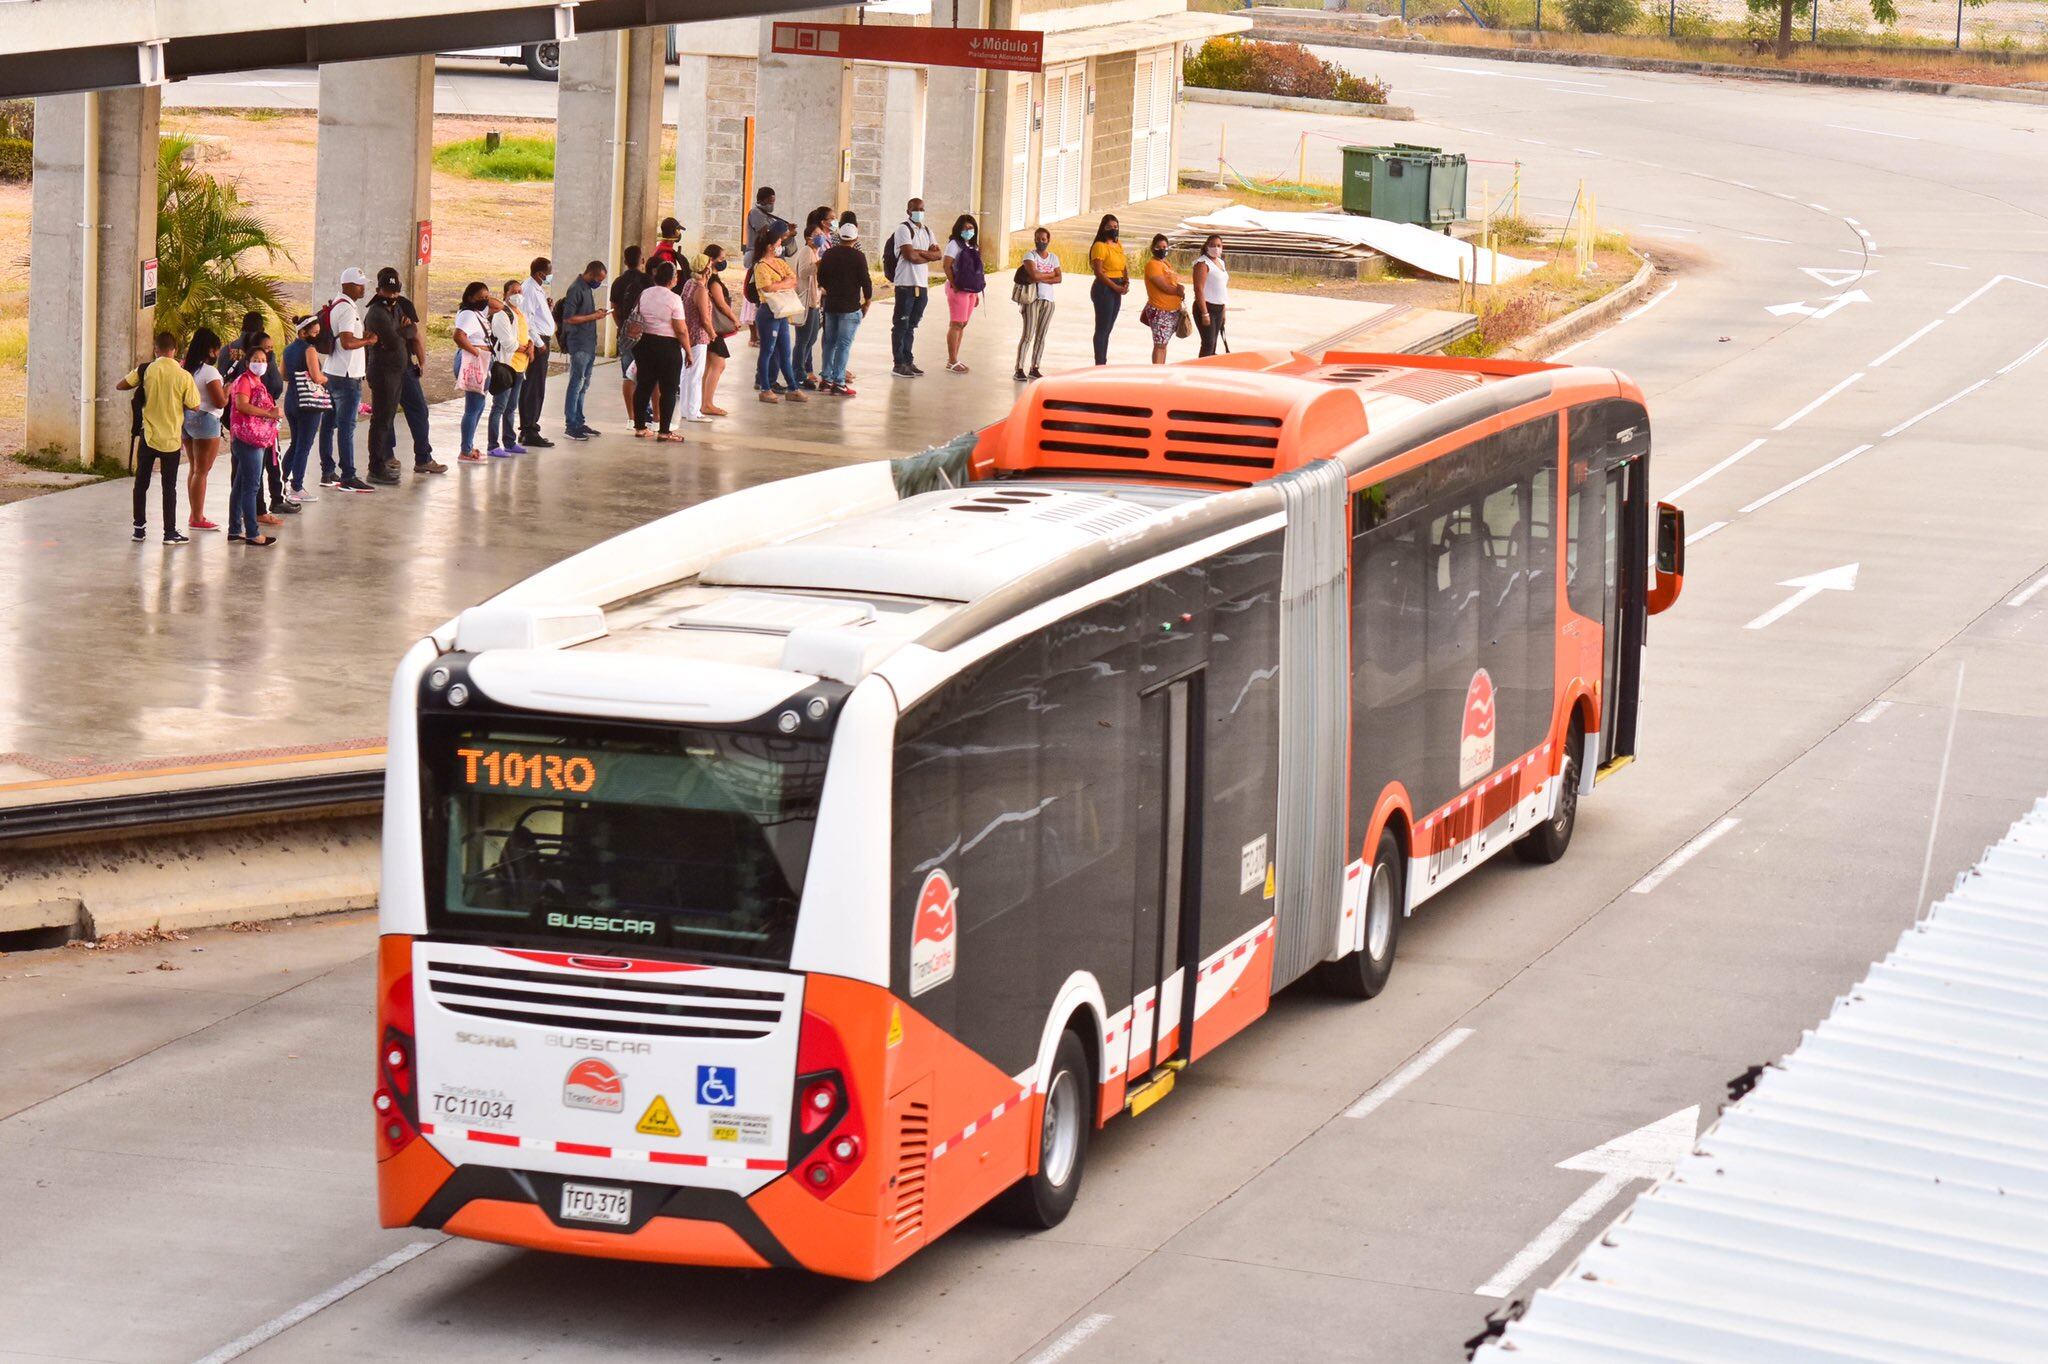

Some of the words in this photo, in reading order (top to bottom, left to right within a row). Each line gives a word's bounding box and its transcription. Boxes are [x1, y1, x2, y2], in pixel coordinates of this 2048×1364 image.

[983, 37, 1028, 53] Módulo
[1032, 41, 1038, 53] 1
[457, 749, 596, 792] T101RO
[547, 912, 656, 935] BUSSCAR
[455, 1031, 518, 1050] SCANIA
[544, 1034, 651, 1055] BUSSCAR
[433, 1094, 513, 1120] TC11034
[567, 1091, 619, 1107] TransCaribe
